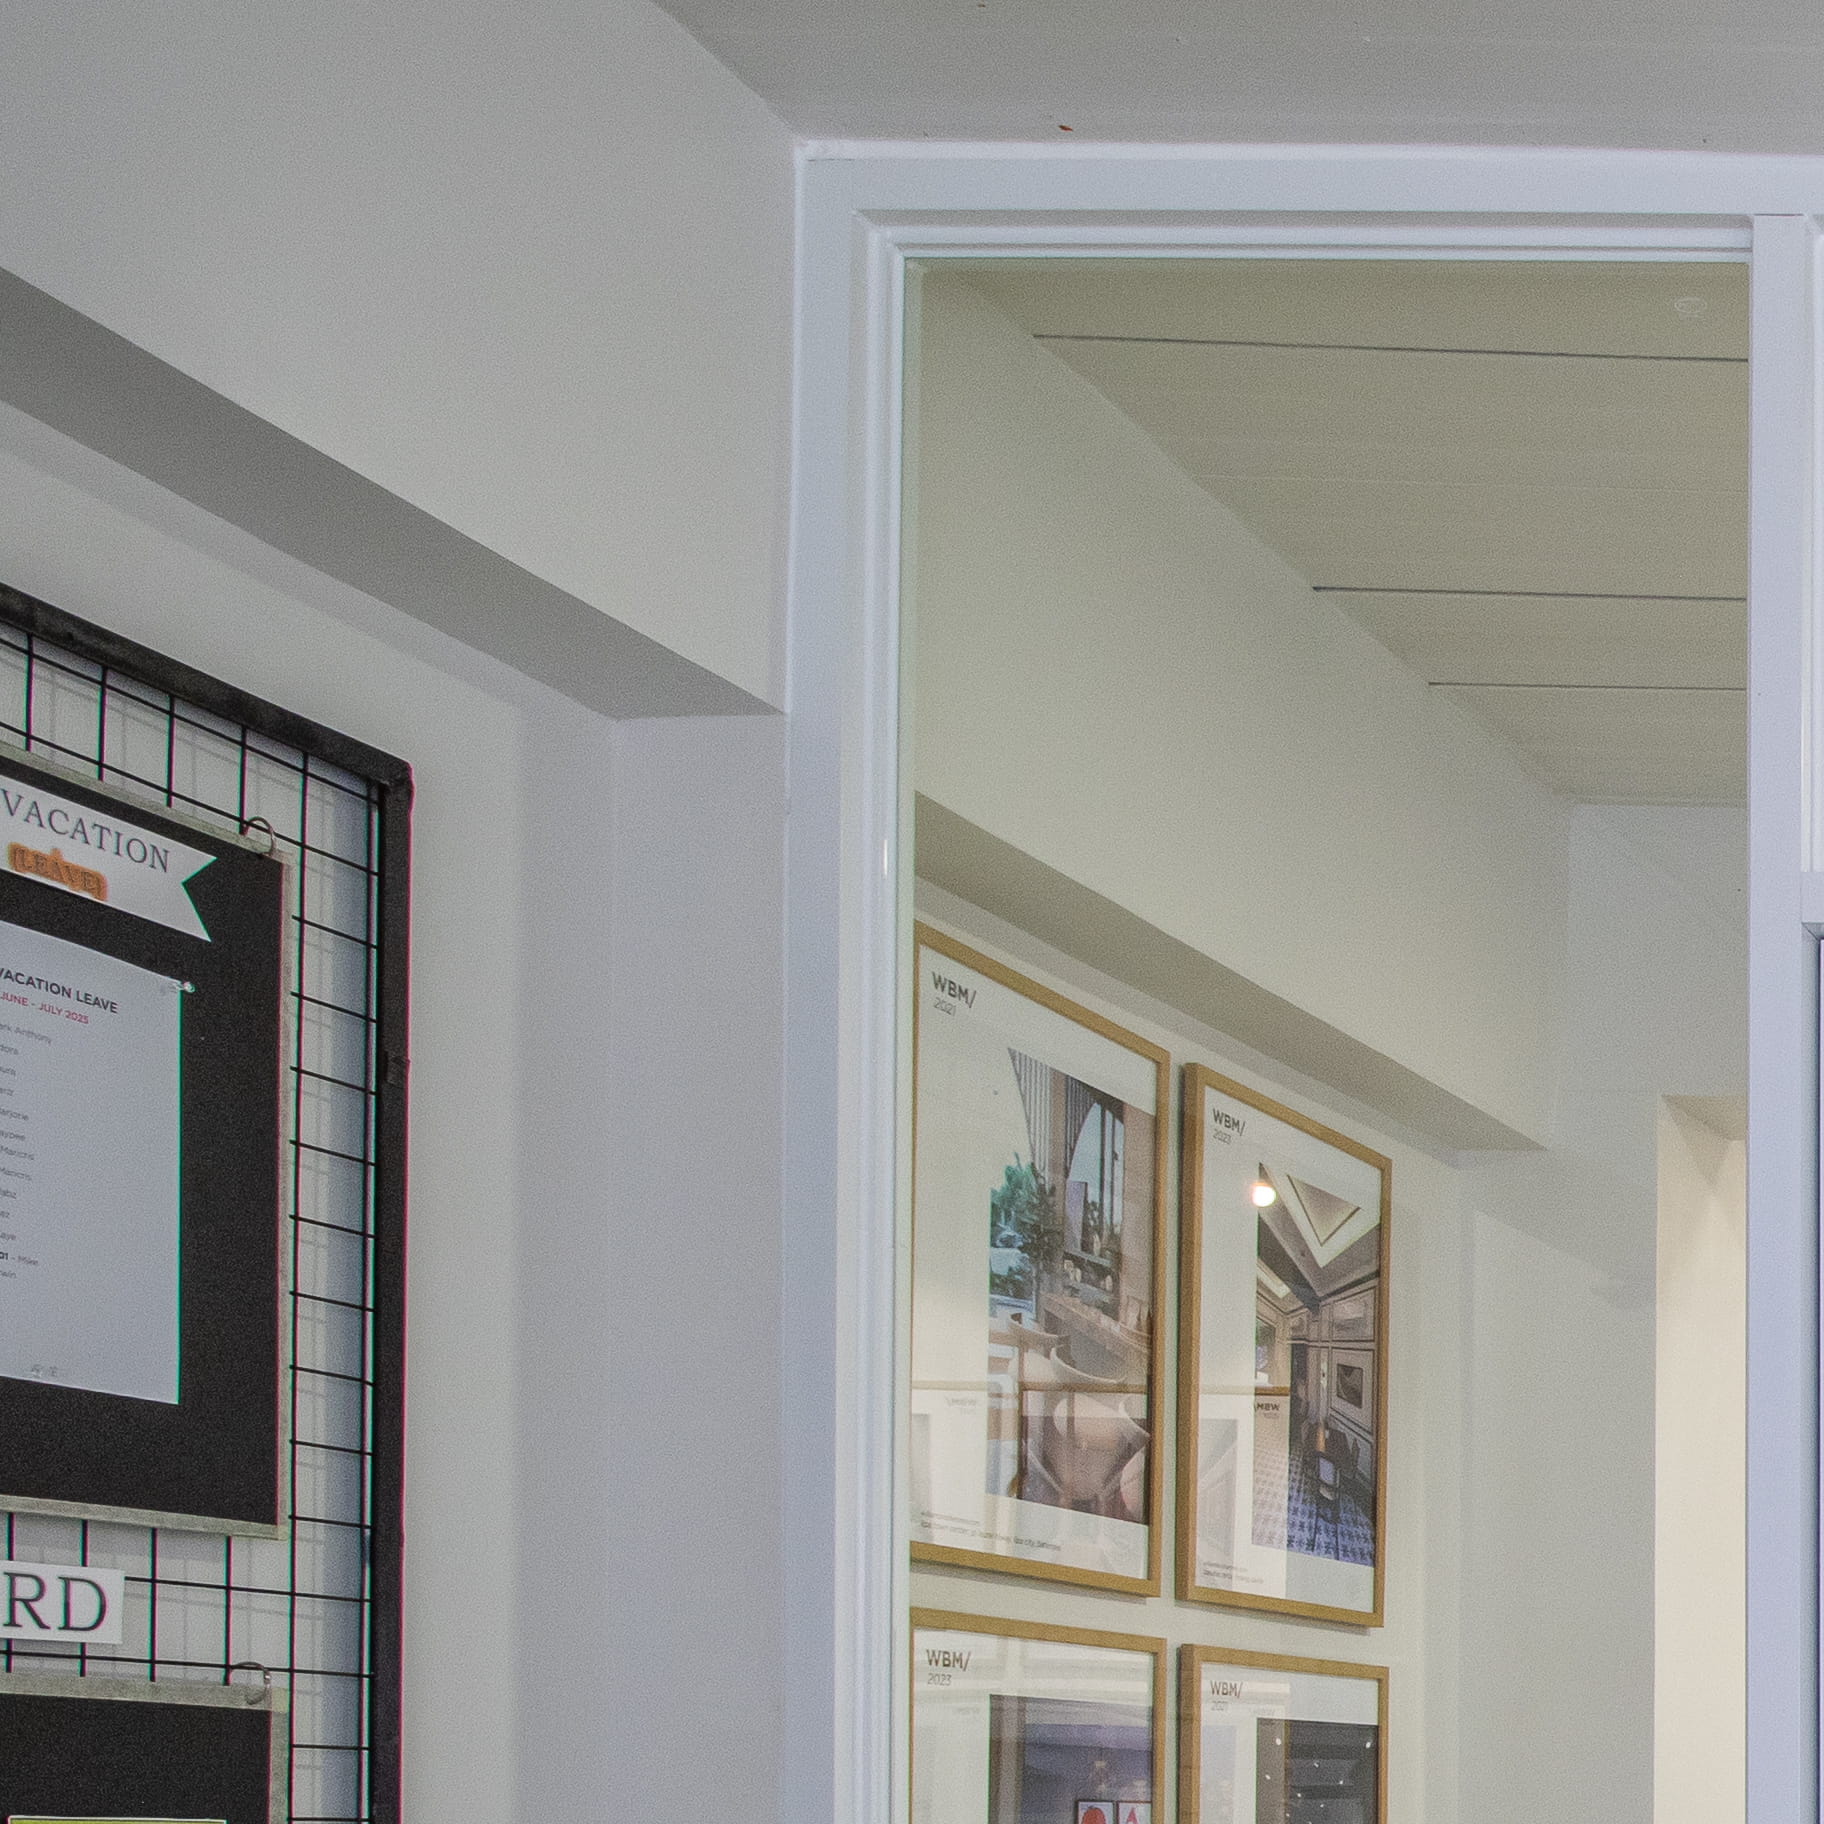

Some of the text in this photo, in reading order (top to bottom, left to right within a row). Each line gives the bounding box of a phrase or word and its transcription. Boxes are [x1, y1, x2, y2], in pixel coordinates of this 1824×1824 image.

[1, 789, 170, 873] VACATION
[932, 971, 977, 1008] WBM/
[38, 1003, 63, 1016] JULY
[65, 1010, 89, 1024] 2025
[76, 990, 118, 1014] LEAVE
[1213, 1108, 1246, 1137] WBM/
[926, 1648, 971, 1671] WBM/
[1210, 1680, 1243, 1699] WBM/
